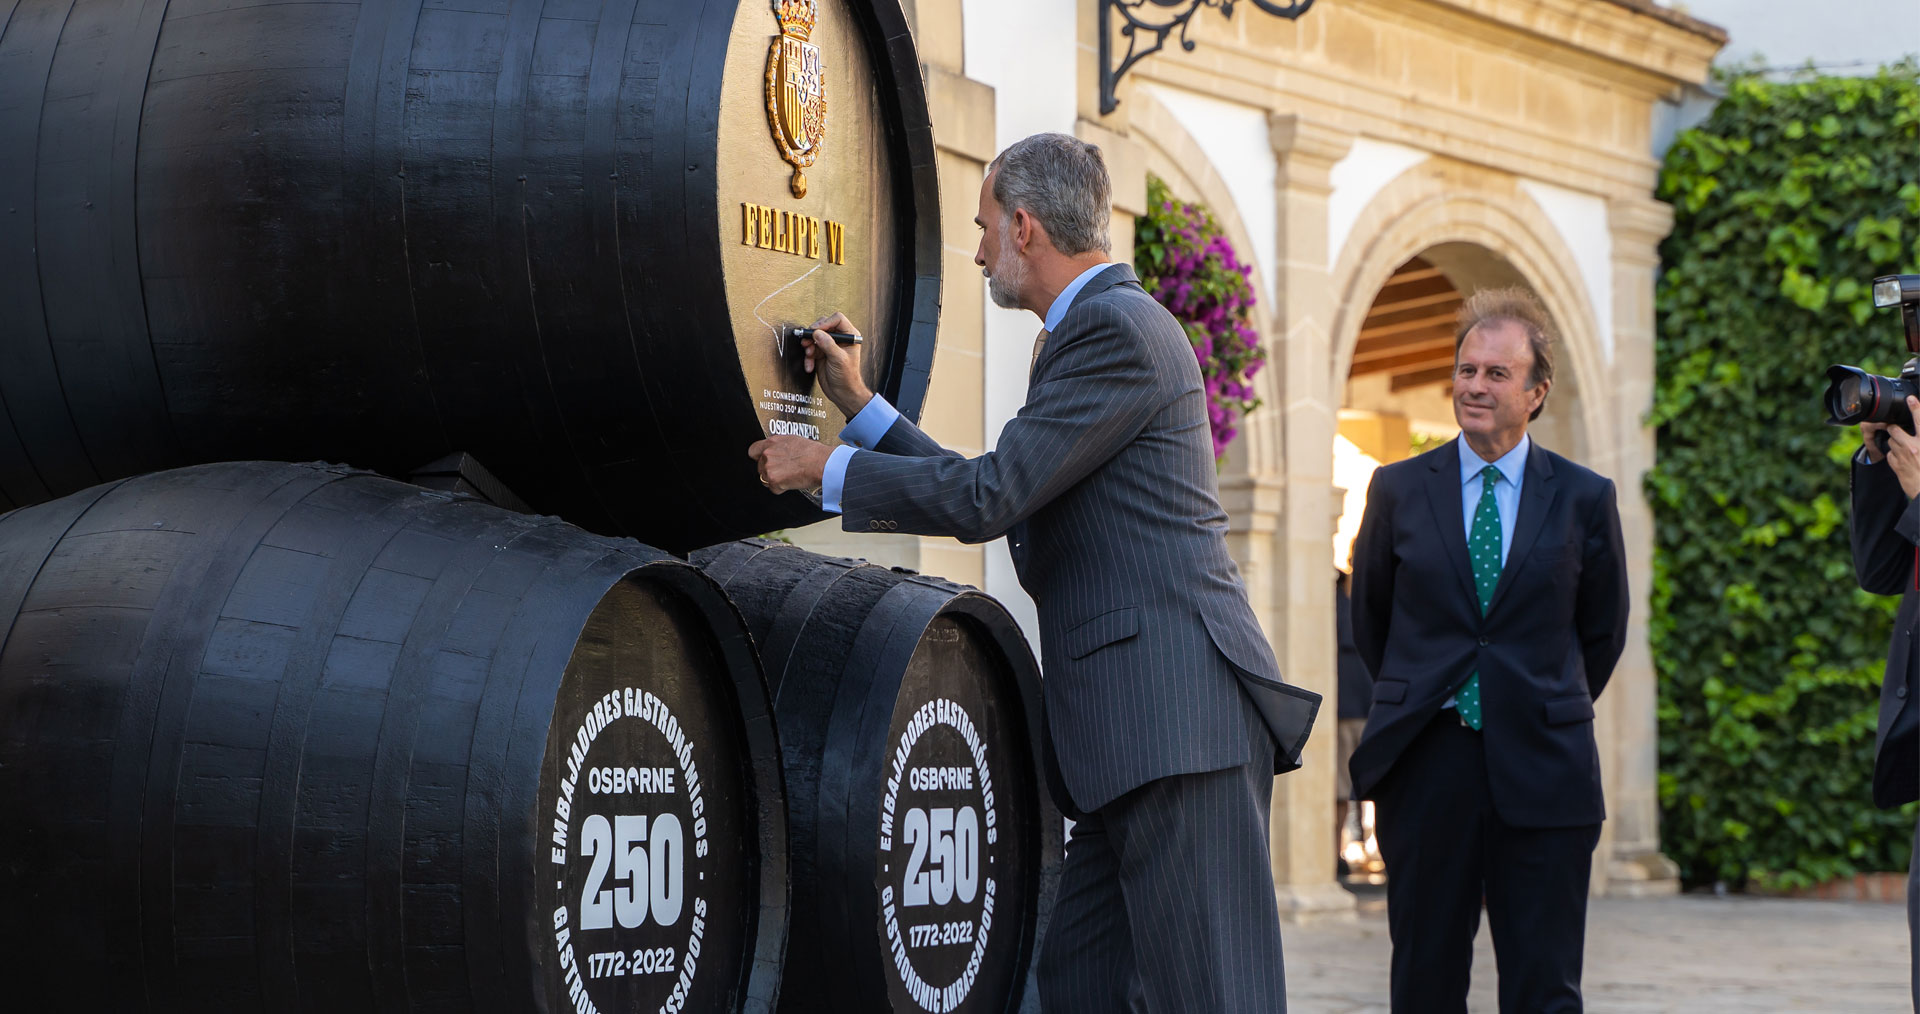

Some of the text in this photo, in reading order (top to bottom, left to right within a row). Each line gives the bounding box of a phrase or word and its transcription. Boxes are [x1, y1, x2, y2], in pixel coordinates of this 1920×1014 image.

[741, 202, 845, 265] FELIPE VI
[760, 401, 784, 412] NUESTRO
[797, 406, 826, 419] ANIVERSARIO
[763, 389, 771, 398] EN
[816, 397, 823, 406] DE
[552, 687, 709, 864] EMBAJADORES GASTRONÓMICOS
[588, 766, 675, 794] OSBORNE
[880, 698, 997, 851] EMBAJADORES GASTRONÓMICOS
[910, 766, 973, 791] OSBORNE
[580, 812, 684, 930] 250
[903, 806, 979, 907] 250
[659, 897, 707, 1014] SSADORS
[882, 877, 996, 1014] GASTRONOMIC AMBASSADORS
